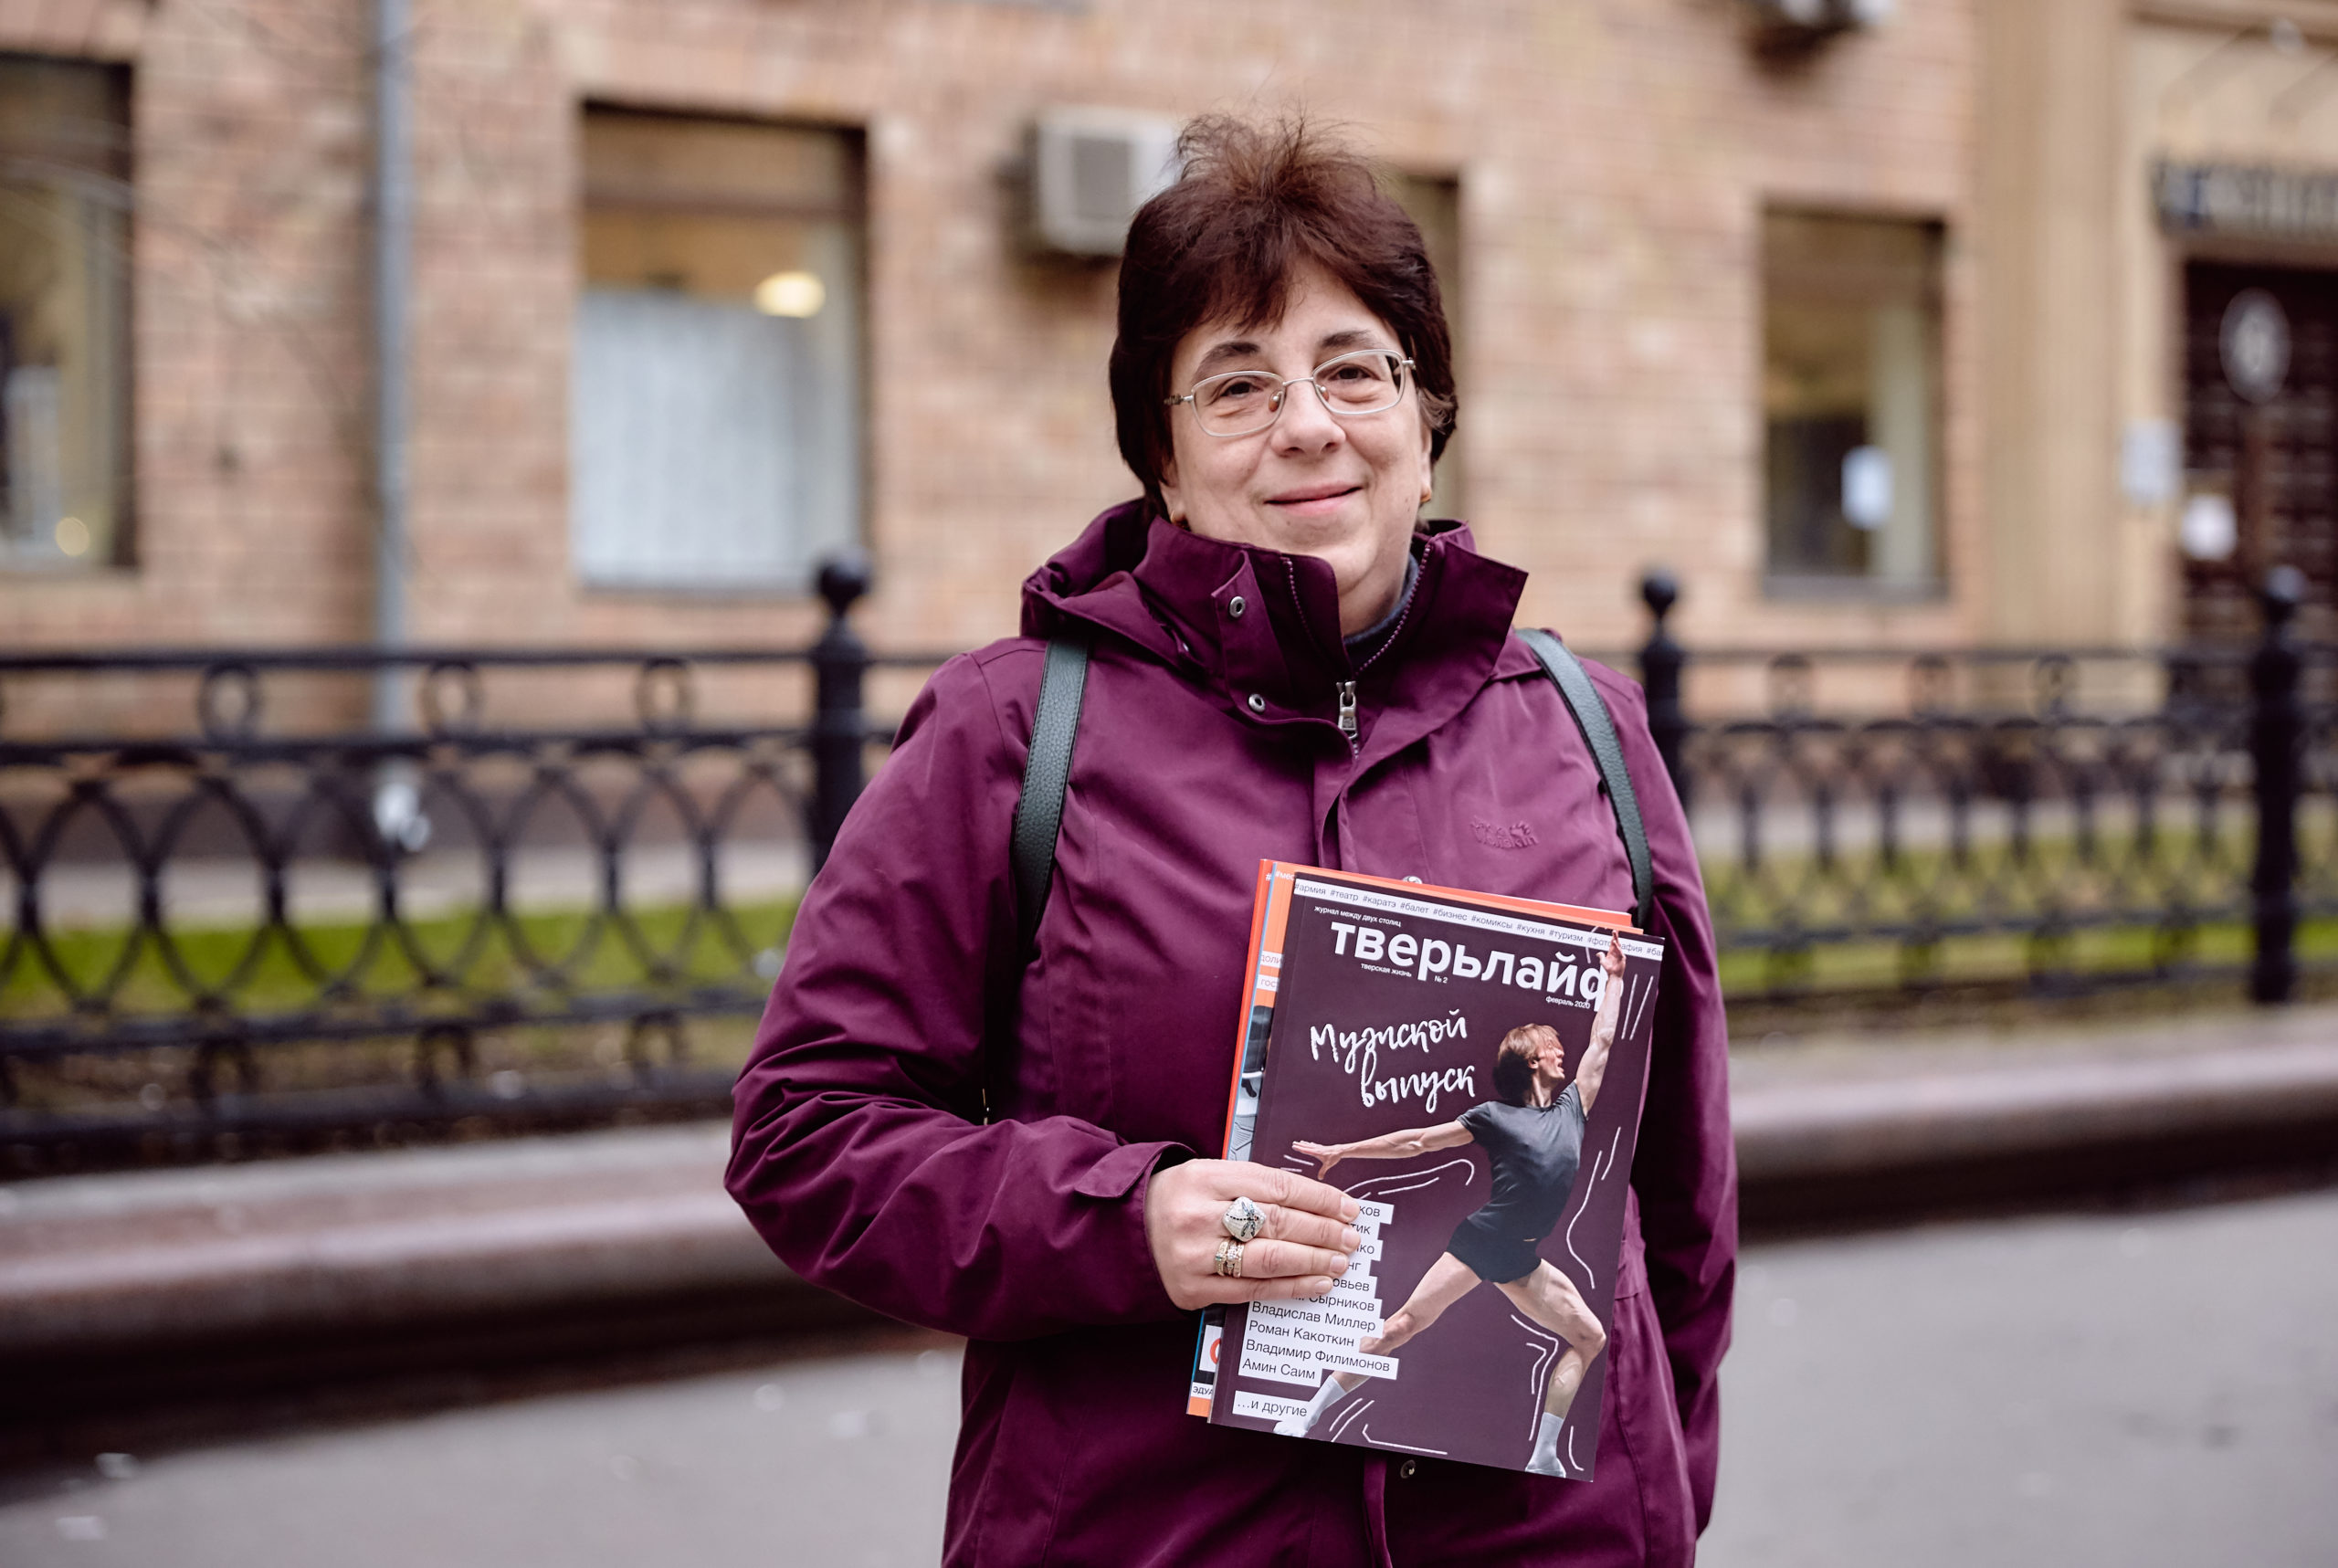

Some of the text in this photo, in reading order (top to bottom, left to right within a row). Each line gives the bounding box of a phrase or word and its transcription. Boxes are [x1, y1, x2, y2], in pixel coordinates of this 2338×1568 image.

[1294, 883, 1326, 895] #армия
[1330, 889, 1359, 901] #театр
[1363, 896, 1396, 908] #каратэ
[1400, 902, 1429, 914] #балет
[1433, 908, 1468, 921] #бизнес
[1471, 915, 1513, 929] #комиксы
[1517, 924, 1545, 936] #кухня
[1549, 930, 1584, 942] #туризм
[1587, 936, 1643, 952] #фотоафия
[1314, 905, 1402, 927] журнал между двух столиц
[1361, 963, 1412, 978] тверская жизнь
[1545, 994, 1591, 1009] февраль 2020
[1310, 1008, 1468, 1074] Мужской
[1361, 1050, 1476, 1114] выпуск
[1252, 1300, 1376, 1332] Владислав Миллер
[1248, 1320, 1354, 1347] Роман Какоткин
[1242, 1358, 1316, 1380] Амин Саим
[1246, 1339, 1311, 1361] Владимир
[1315, 1350, 1390, 1372] Филимонов
[1262, 1401, 1308, 1416] другие
